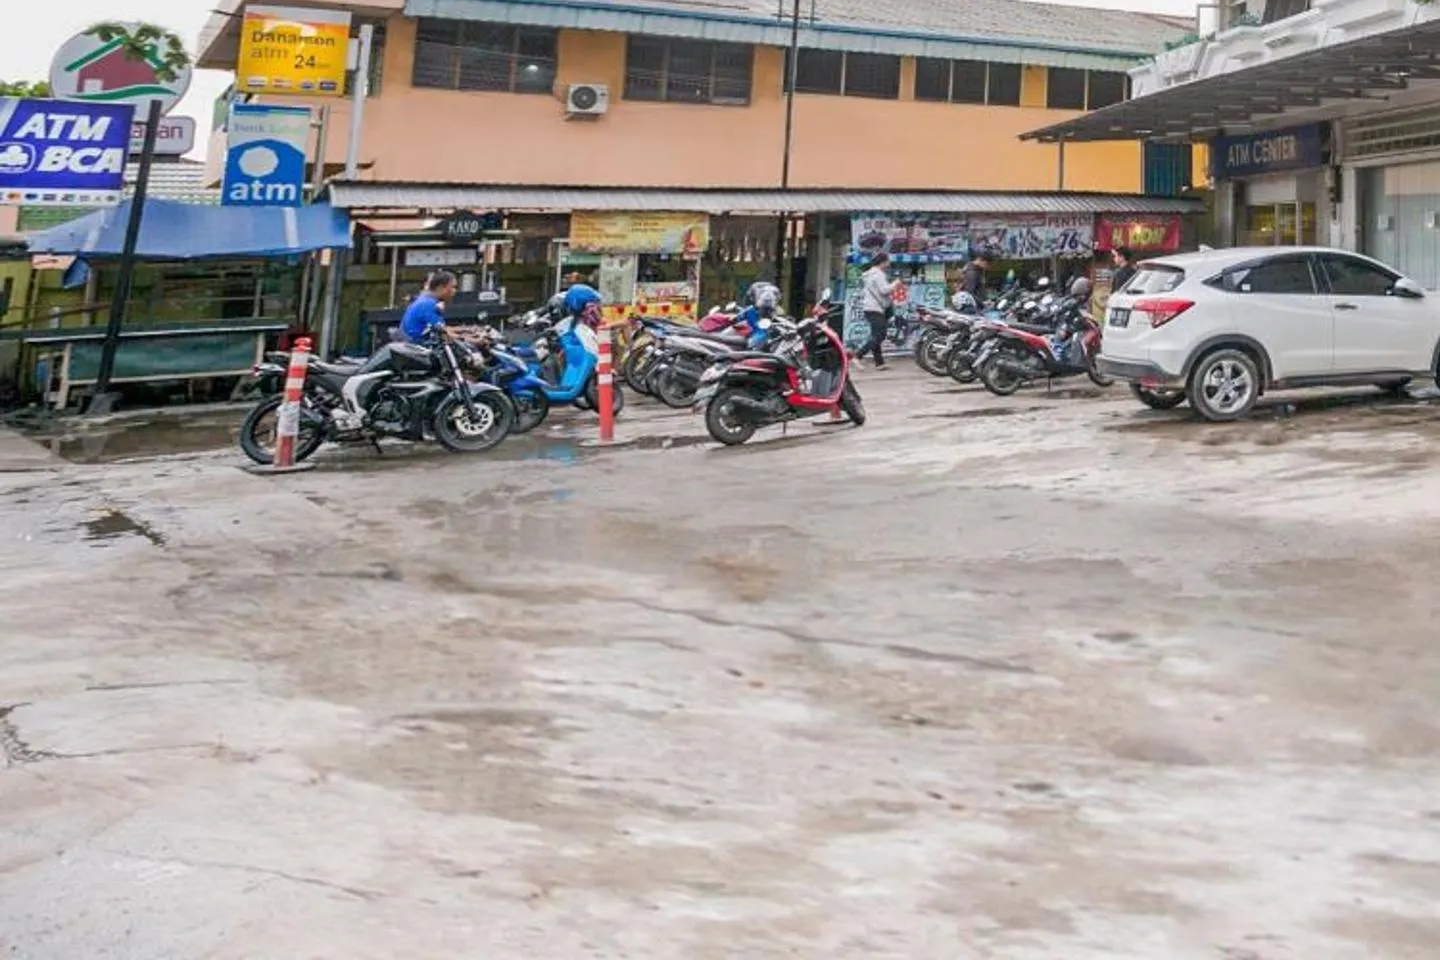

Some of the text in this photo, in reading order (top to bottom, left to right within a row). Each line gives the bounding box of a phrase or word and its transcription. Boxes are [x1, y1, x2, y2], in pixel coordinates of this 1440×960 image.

[251, 46, 290, 59] atm
[294, 54, 316, 69] 24
[14, 113, 112, 140] ATM
[37, 145, 124, 174] BCA
[1226, 135, 1297, 168] ATM CENTER
[229, 179, 297, 201] atm
